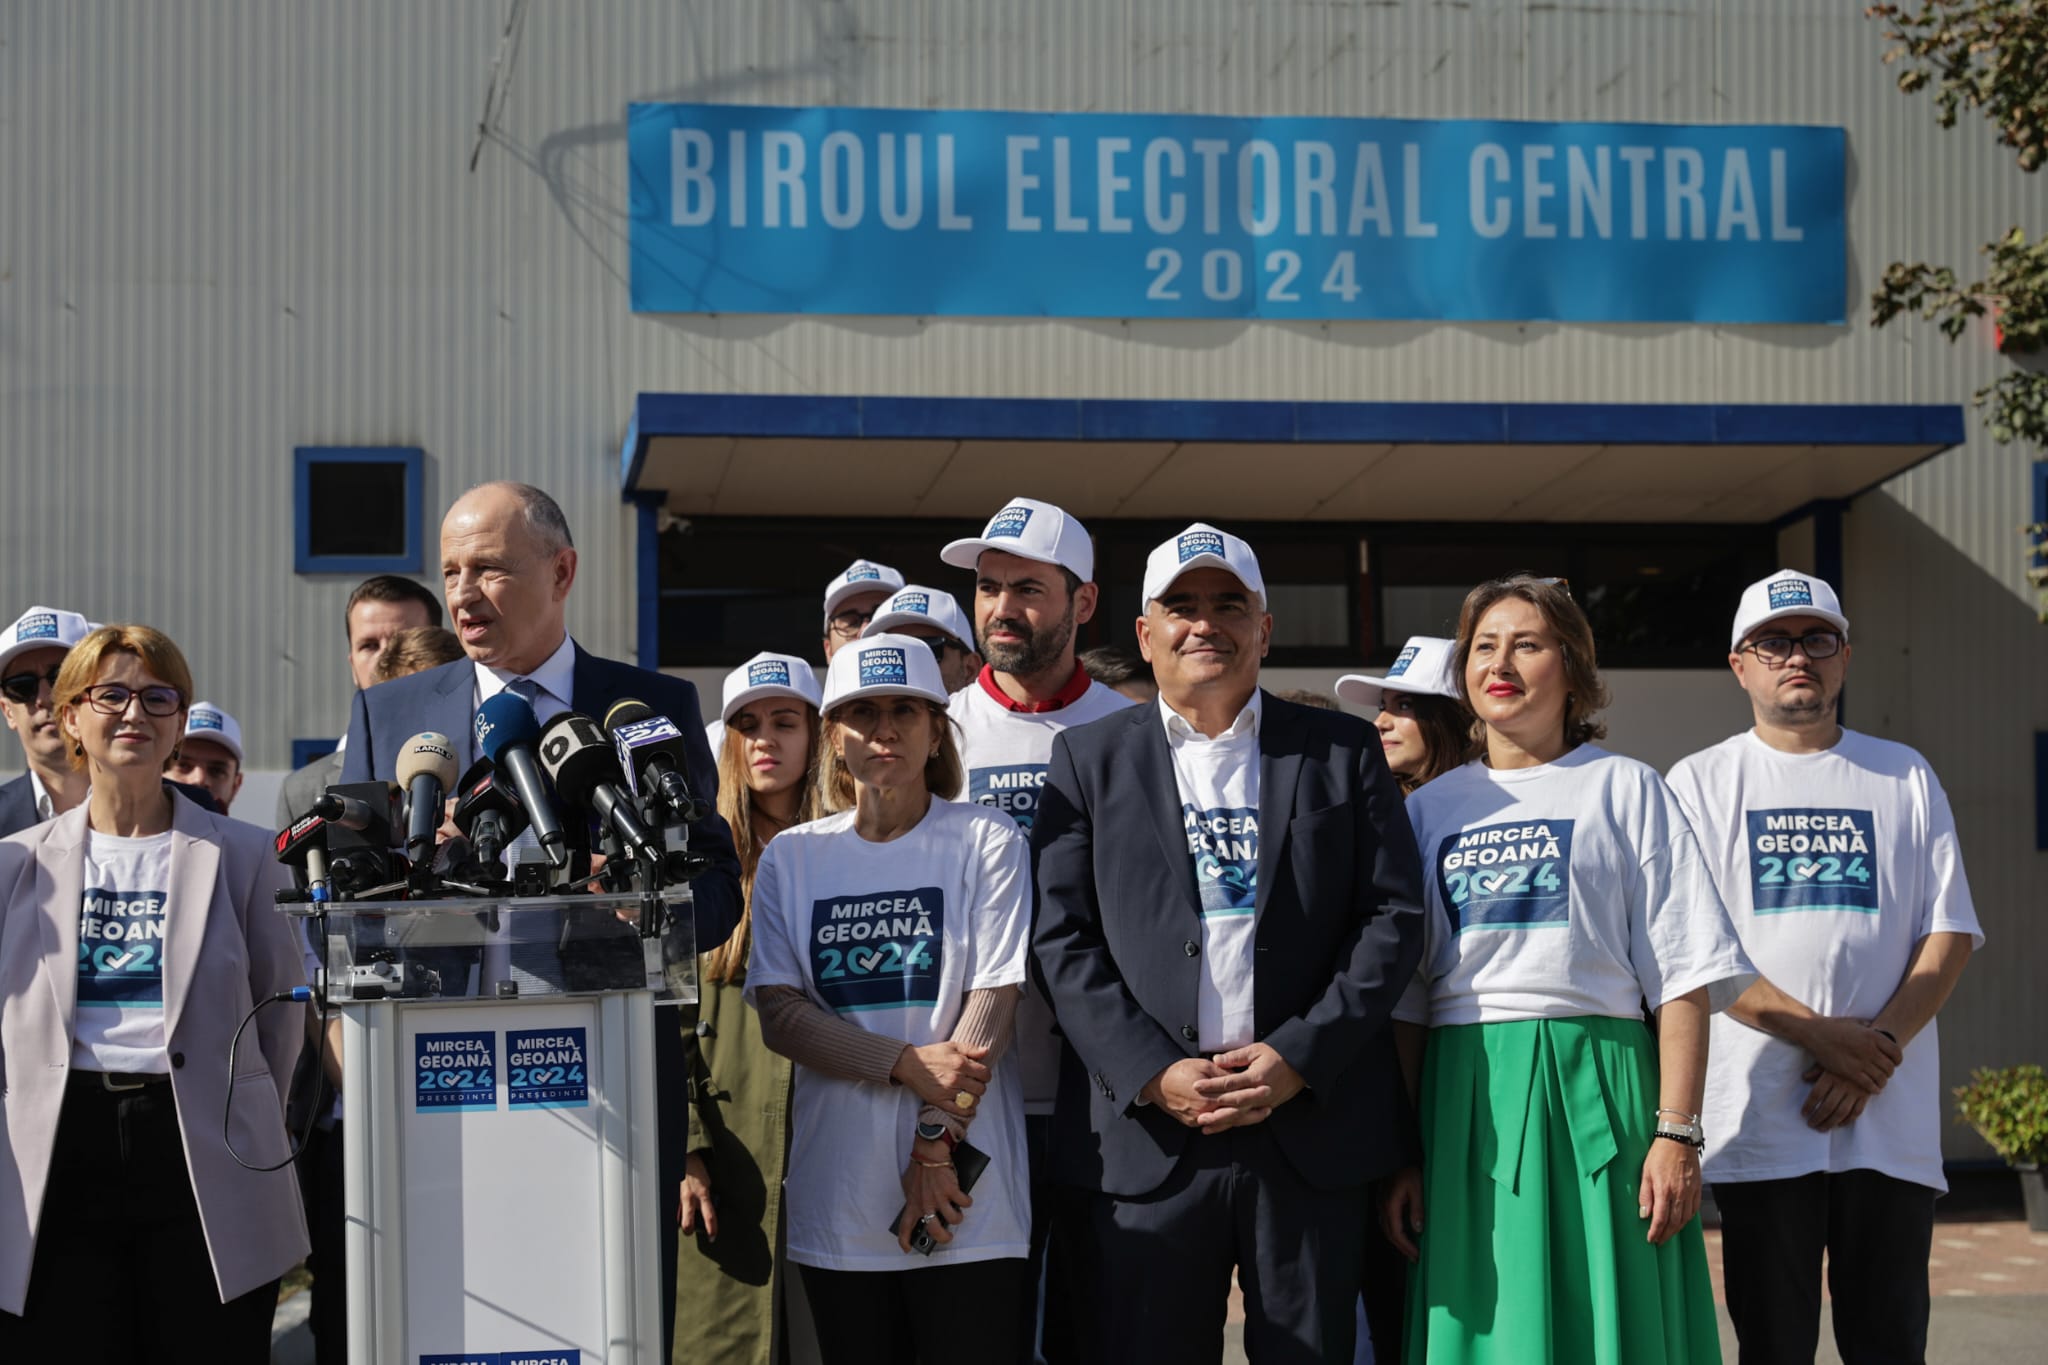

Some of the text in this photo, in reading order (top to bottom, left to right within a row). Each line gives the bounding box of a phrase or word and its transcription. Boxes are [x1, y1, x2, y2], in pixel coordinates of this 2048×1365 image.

[670, 128, 1804, 242] BIROUL ELECTORAL CENTRAL
[1145, 247, 1362, 302] 2024
[865, 650, 899, 658] MIRCEA
[862, 665, 905, 678] 2024
[625, 724, 681, 743] 24
[415, 745, 445, 755] KANAL
[989, 771, 1048, 789] MIRC
[978, 791, 1039, 811] GEO
[1184, 810, 1258, 835] MRCEA
[1766, 815, 1857, 831] MIRCEA
[1187, 831, 1258, 860] EOAN
[1458, 825, 1551, 849] MIRCEA
[1756, 830, 1869, 854] GEOANĂ
[1443, 836, 1561, 870] GEOANĂ
[1758, 857, 1871, 883] 2024
[1445, 862, 1561, 903] 2024
[831, 897, 923, 920] MIRCEA
[80, 917, 165, 942] EOAN
[817, 910, 934, 944] GEOANĂ
[817, 940, 934, 980] 2024
[426, 1039, 485, 1052] MIRCEA
[517, 1036, 576, 1050] MIRCEA
[419, 1050, 492, 1068] GEOANĂ
[510, 1046, 583, 1066] GEOANĂ
[419, 1069, 493, 1089] 2024
[510, 1065, 584, 1087] 2024
